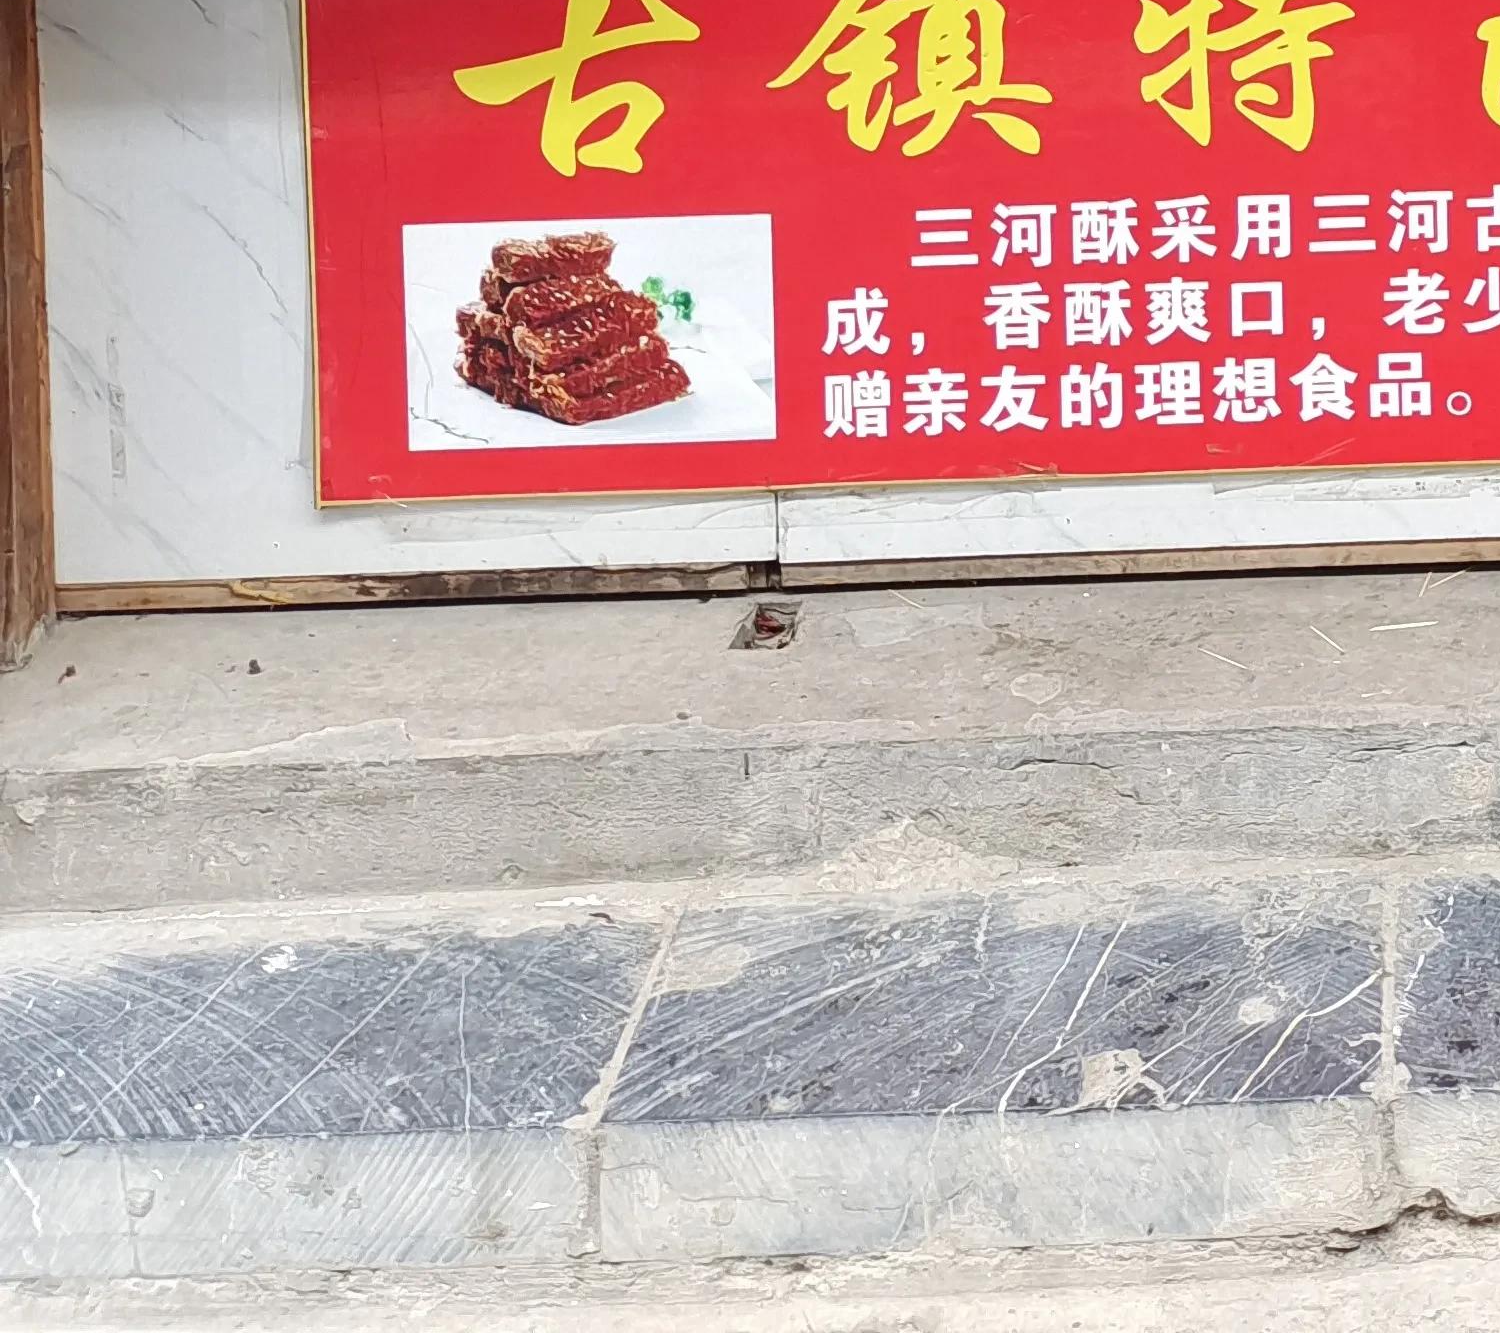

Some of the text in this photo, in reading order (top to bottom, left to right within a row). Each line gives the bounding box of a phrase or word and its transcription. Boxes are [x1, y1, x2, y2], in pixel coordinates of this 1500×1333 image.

[823, 352, 1472, 438] 赠亲友的理想食品。
